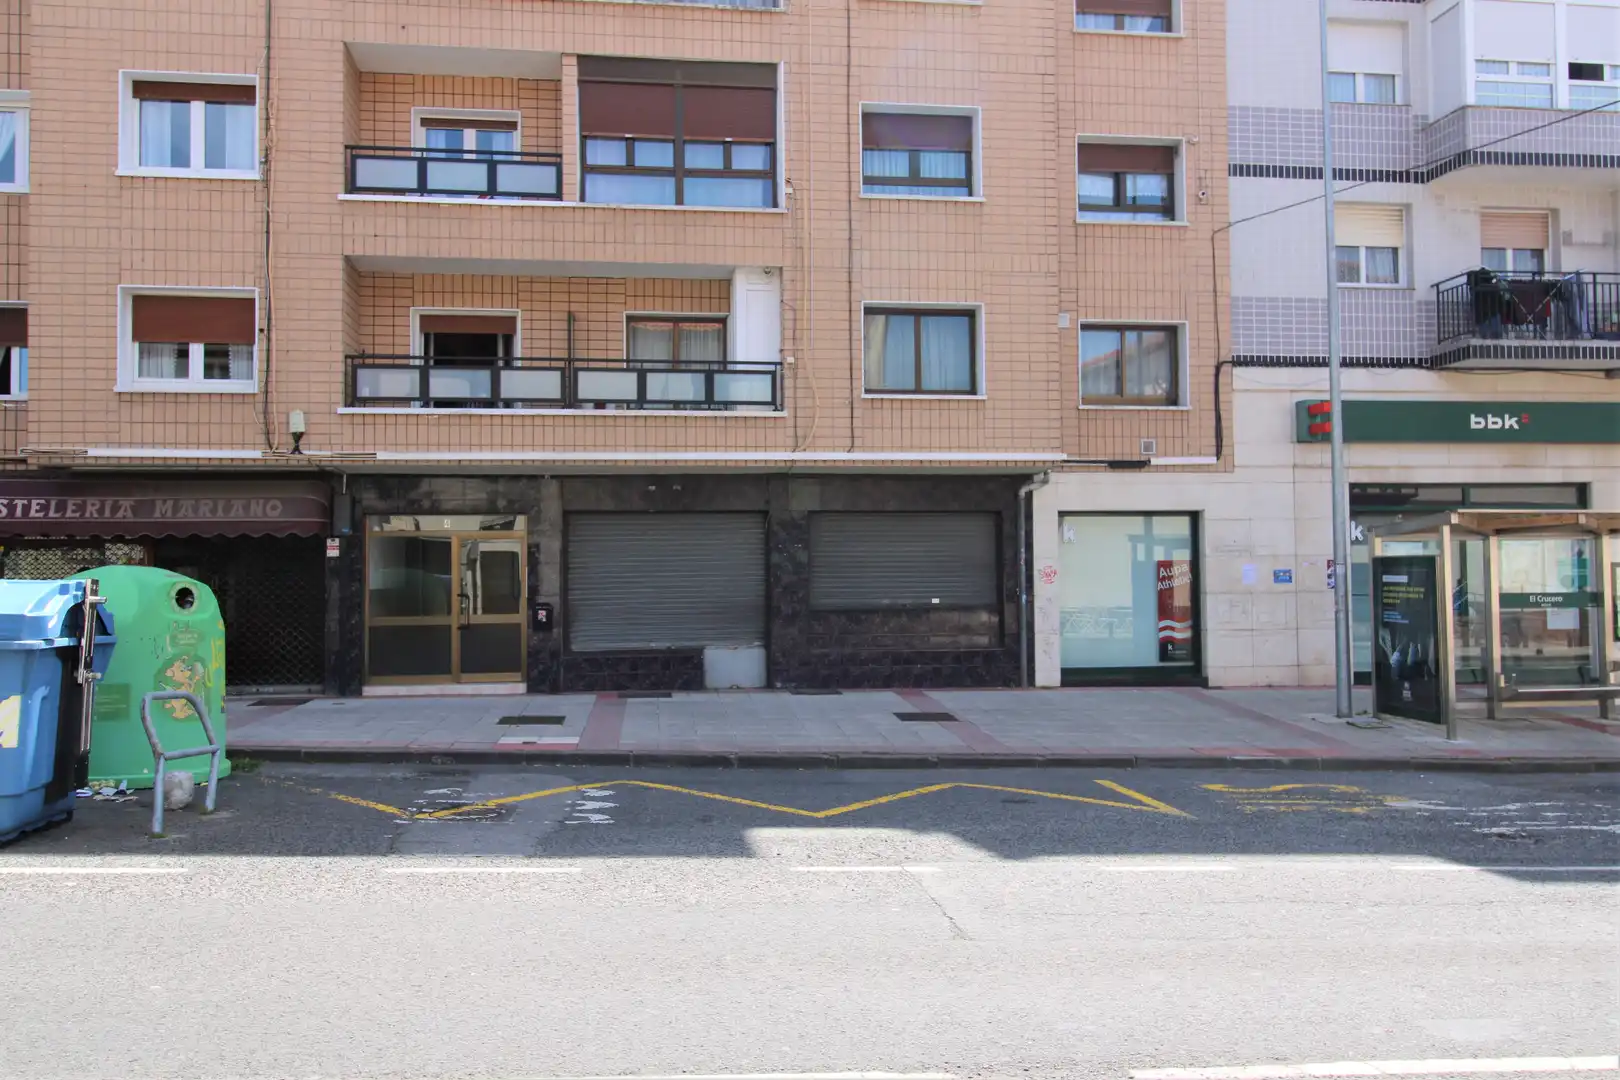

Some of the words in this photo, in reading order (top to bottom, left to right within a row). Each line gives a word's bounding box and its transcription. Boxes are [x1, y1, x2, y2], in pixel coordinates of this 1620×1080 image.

[1470, 413, 1520, 430] bbk
[153, 499, 283, 518] MARIANO
[1160, 563, 1189, 579] Aupa
[1529, 595, 1536, 603] El
[1537, 595, 1563, 603] Crucero
